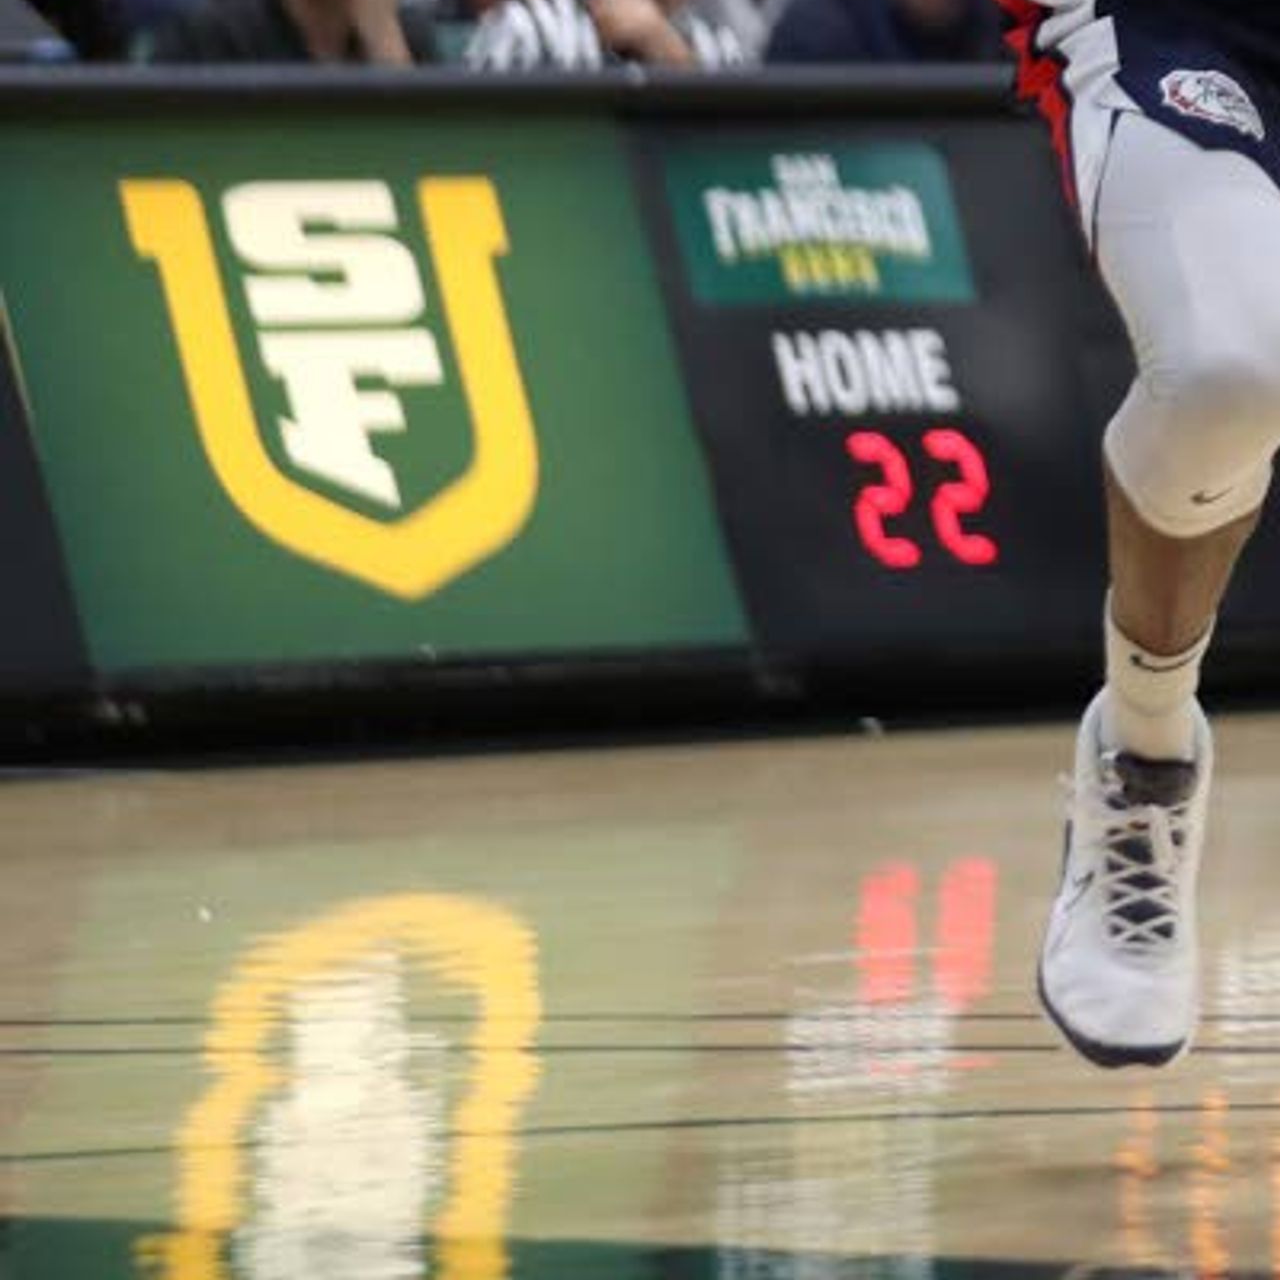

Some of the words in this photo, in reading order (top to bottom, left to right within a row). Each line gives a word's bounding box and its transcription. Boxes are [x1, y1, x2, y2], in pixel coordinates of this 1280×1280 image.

[703, 184, 933, 265] FRANCISCO
[770, 328, 960, 417] HOME
[845, 427, 998, 570] 22
